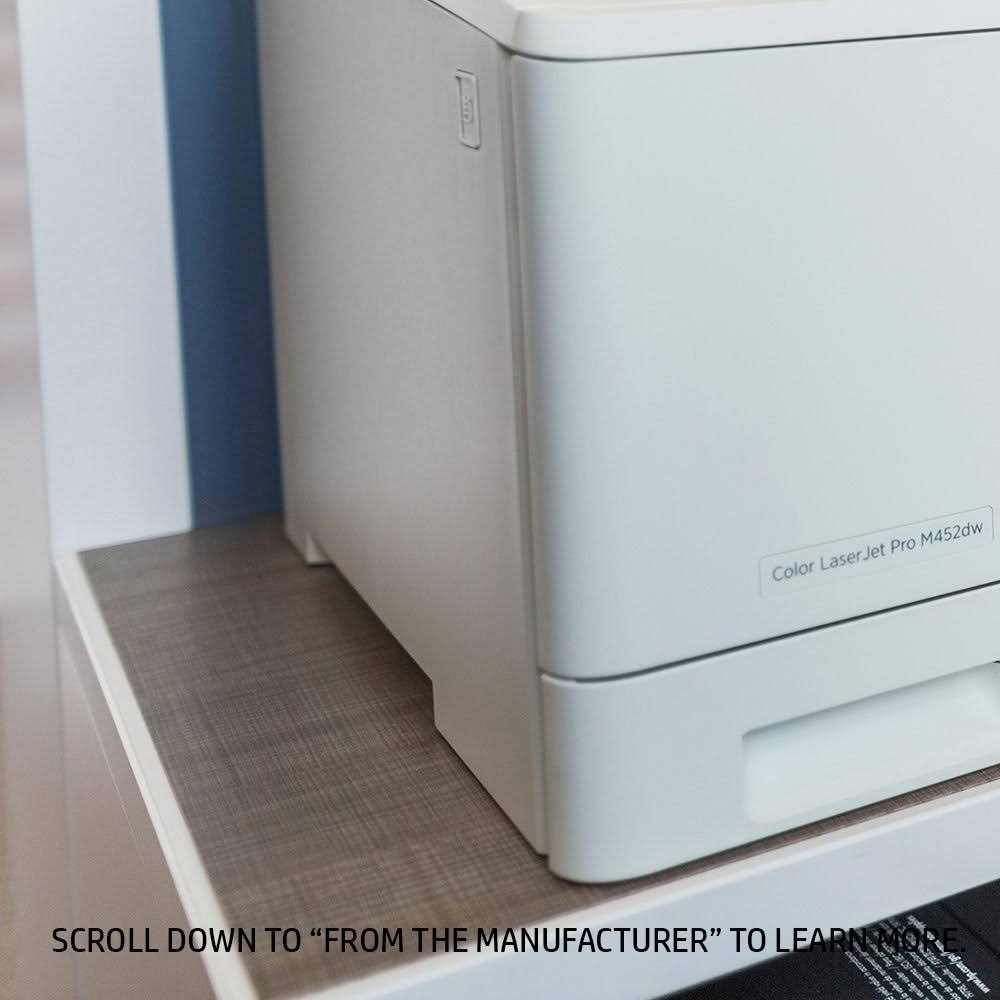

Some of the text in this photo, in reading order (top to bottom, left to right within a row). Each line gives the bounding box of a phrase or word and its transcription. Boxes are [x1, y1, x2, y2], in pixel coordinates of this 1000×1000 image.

[771, 521, 984, 582] Color LaserJet Pro M452dw
